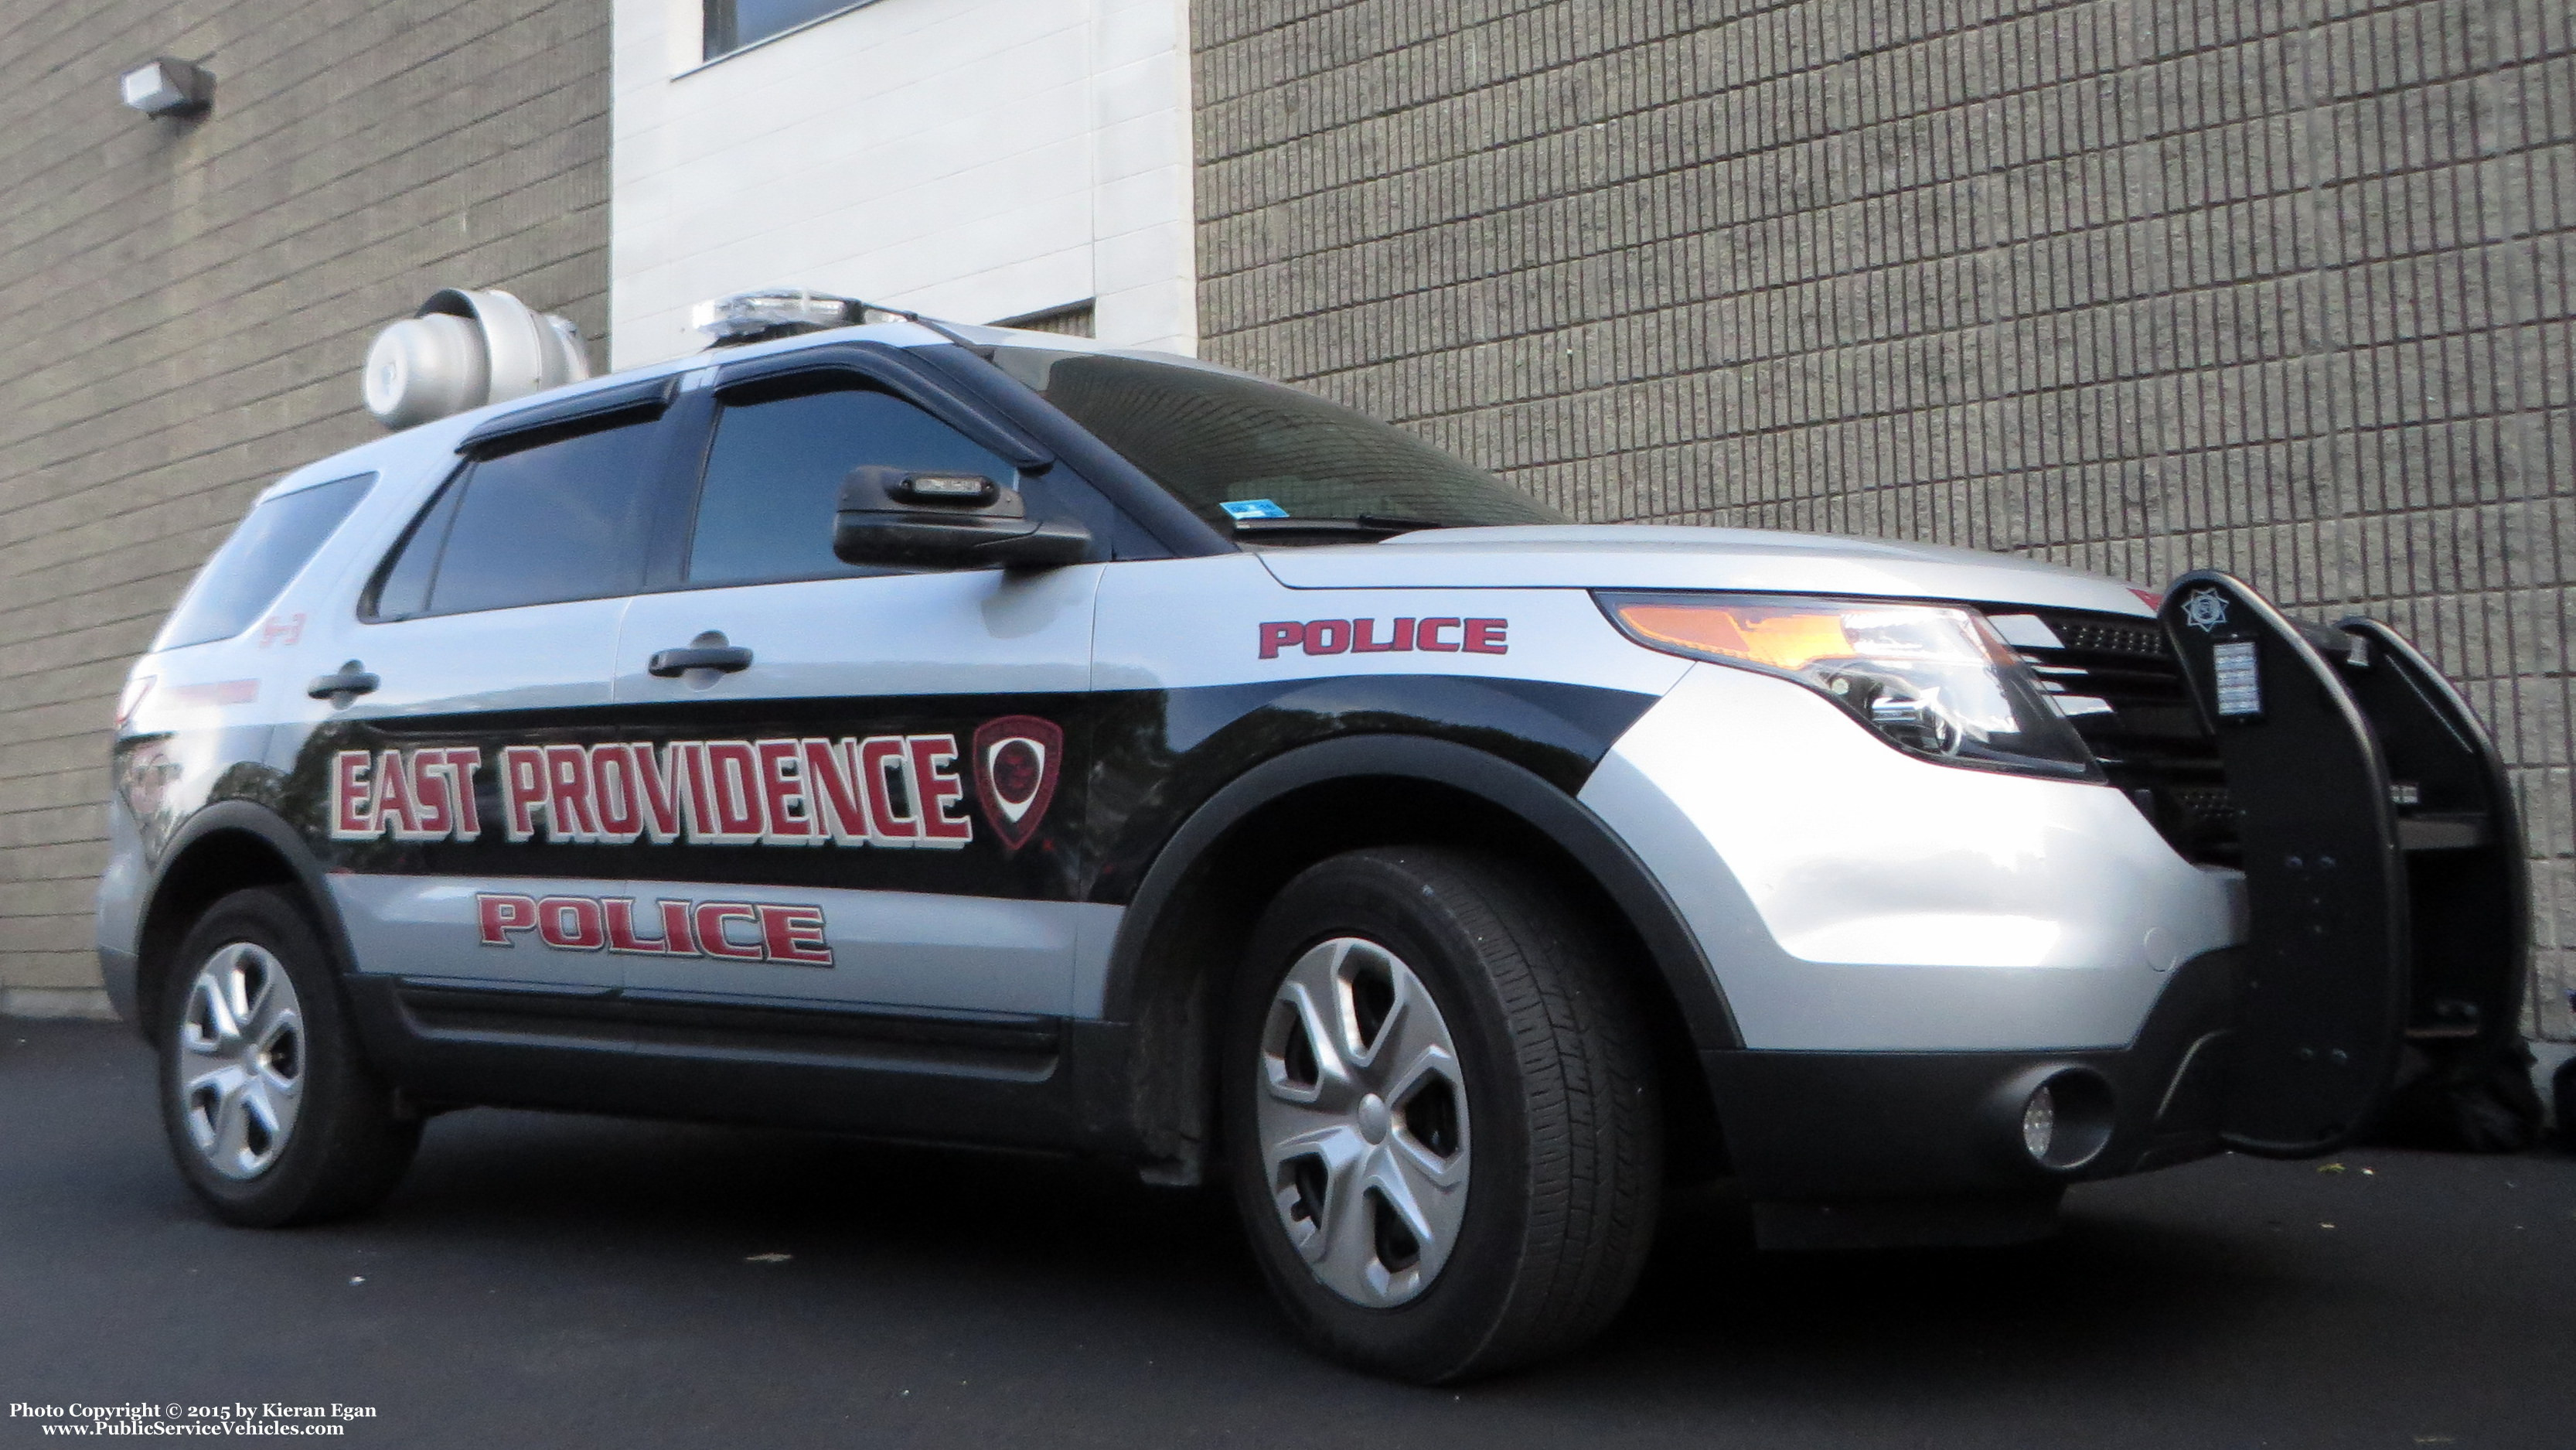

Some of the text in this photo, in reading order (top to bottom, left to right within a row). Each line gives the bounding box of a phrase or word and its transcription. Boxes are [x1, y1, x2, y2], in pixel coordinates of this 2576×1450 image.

[1258, 616, 1508, 660] POLICE
[331, 748, 482, 842] EAST
[499, 734, 973, 849] PROVIDENCE
[475, 892, 835, 968] POLICE
